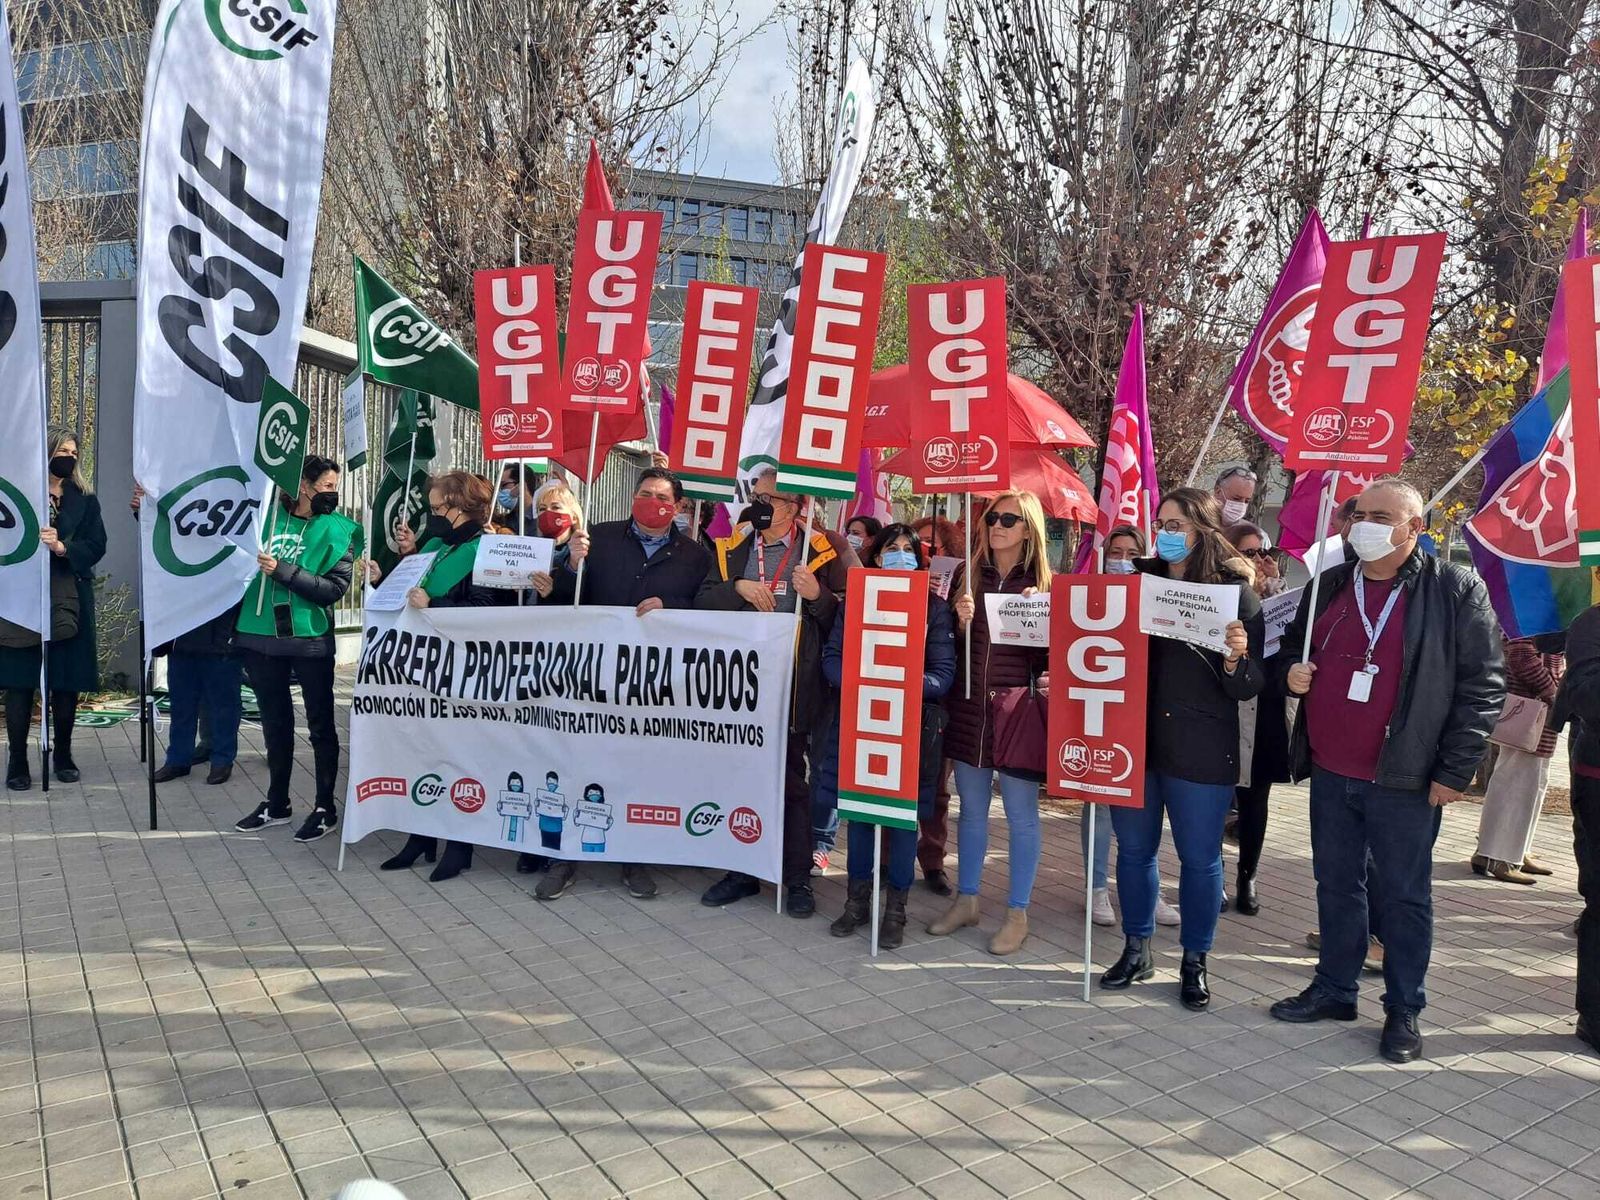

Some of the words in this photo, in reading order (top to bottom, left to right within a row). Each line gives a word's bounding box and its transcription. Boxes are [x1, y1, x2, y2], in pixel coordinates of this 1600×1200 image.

[228, 0, 319, 51] CSIF
[158, 102, 290, 404] CSIF
[586, 220, 644, 355] UGT
[1327, 245, 1419, 404] UGT
[491, 275, 543, 404] UGT
[796, 252, 868, 464] CCOO
[927, 288, 988, 433] UGT
[683, 288, 744, 471] CCOO
[521, 413, 539, 424] FSP
[864, 405, 889, 417] .G.T.
[1310, 414, 1341, 430] UGT
[1350, 416, 1376, 428] FSP
[267, 419, 300, 455] CSIF
[928, 443, 953, 457] UGT
[961, 442, 981, 453] FSP
[489, 549, 537, 559] PROFESIONAL
[505, 559, 519, 567] YA!
[1005, 601, 1050, 609] ¡CARRERA
[1156, 595, 1220, 613] PROFESIONAL
[1164, 589, 1212, 603] ¡CARRERA
[1021, 620, 1038, 628] YA!
[1178, 609, 1195, 619] YA!
[1067, 585, 1127, 737] UGT
[459, 639, 607, 703] PROFESIONAL
[614, 644, 675, 707] PARA
[682, 647, 759, 712] TODOS
[855, 575, 911, 791] CCOO
[351, 692, 426, 718] ROMOCIÓN
[430, 697, 448, 718] DE
[452, 704, 477, 719] LOS
[481, 705, 511, 722] AUX.
[514, 706, 626, 735] ADMINISTRATIVOS
[630, 717, 639, 735] A
[643, 717, 764, 747] ADMINISTRATIVOS
[1064, 744, 1087, 761] UGT
[1093, 749, 1115, 761] FSP
[360, 781, 403, 797] CCOO
[419, 783, 447, 797] CSIF
[454, 783, 481, 799] UGT
[631, 808, 677, 822] CCOO
[693, 812, 725, 826] CSIF
[733, 812, 758, 830] UGT
